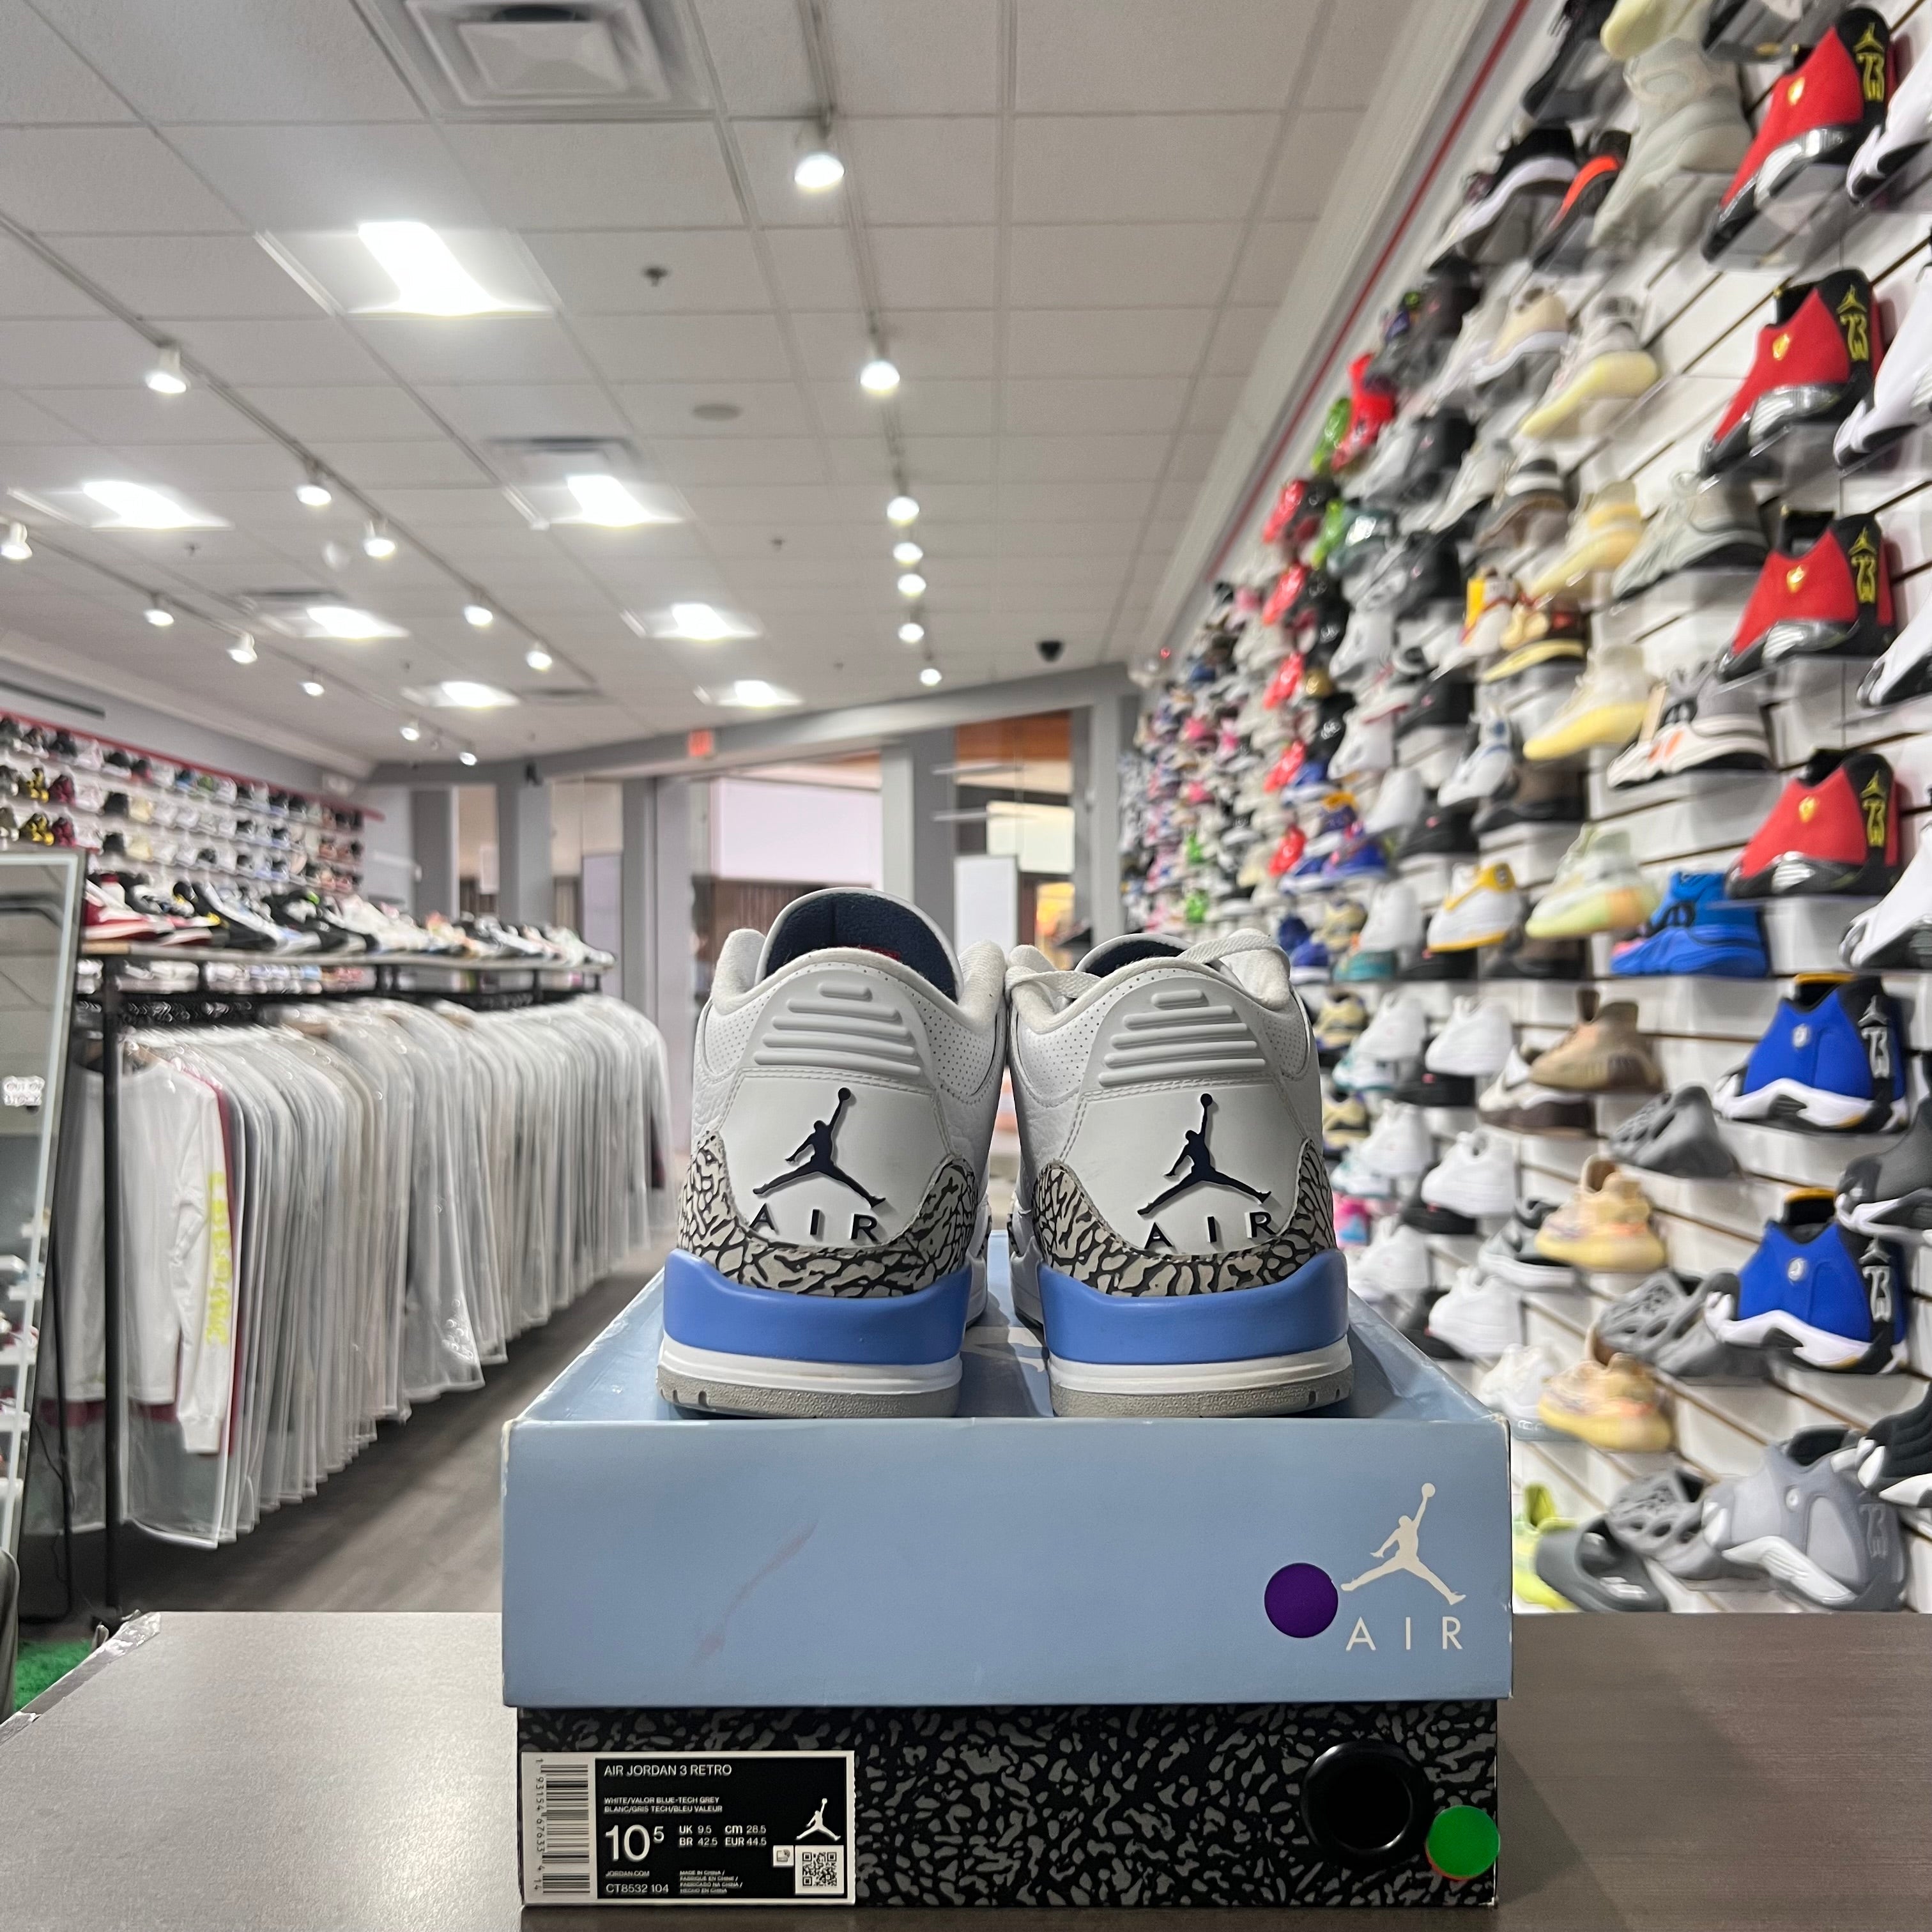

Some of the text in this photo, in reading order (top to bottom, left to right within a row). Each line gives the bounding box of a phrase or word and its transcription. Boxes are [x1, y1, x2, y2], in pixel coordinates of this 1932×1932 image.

[749, 1202, 880, 1244] AIR
[1144, 1211, 1276, 1250] AIR
[1346, 1616, 1463, 1651] AIR
[604, 1764, 732, 1777] AIR JORDAN 3 RETRO
[535, 1777, 544, 1811] 93154
[536, 1818, 545, 1853] 67633
[679, 1825, 766, 1834] UK 9.5 cm 28.5
[679, 1837, 767, 1846] BR 42.5 EUR 44.5
[606, 1883, 669, 1893] CT8532 104
